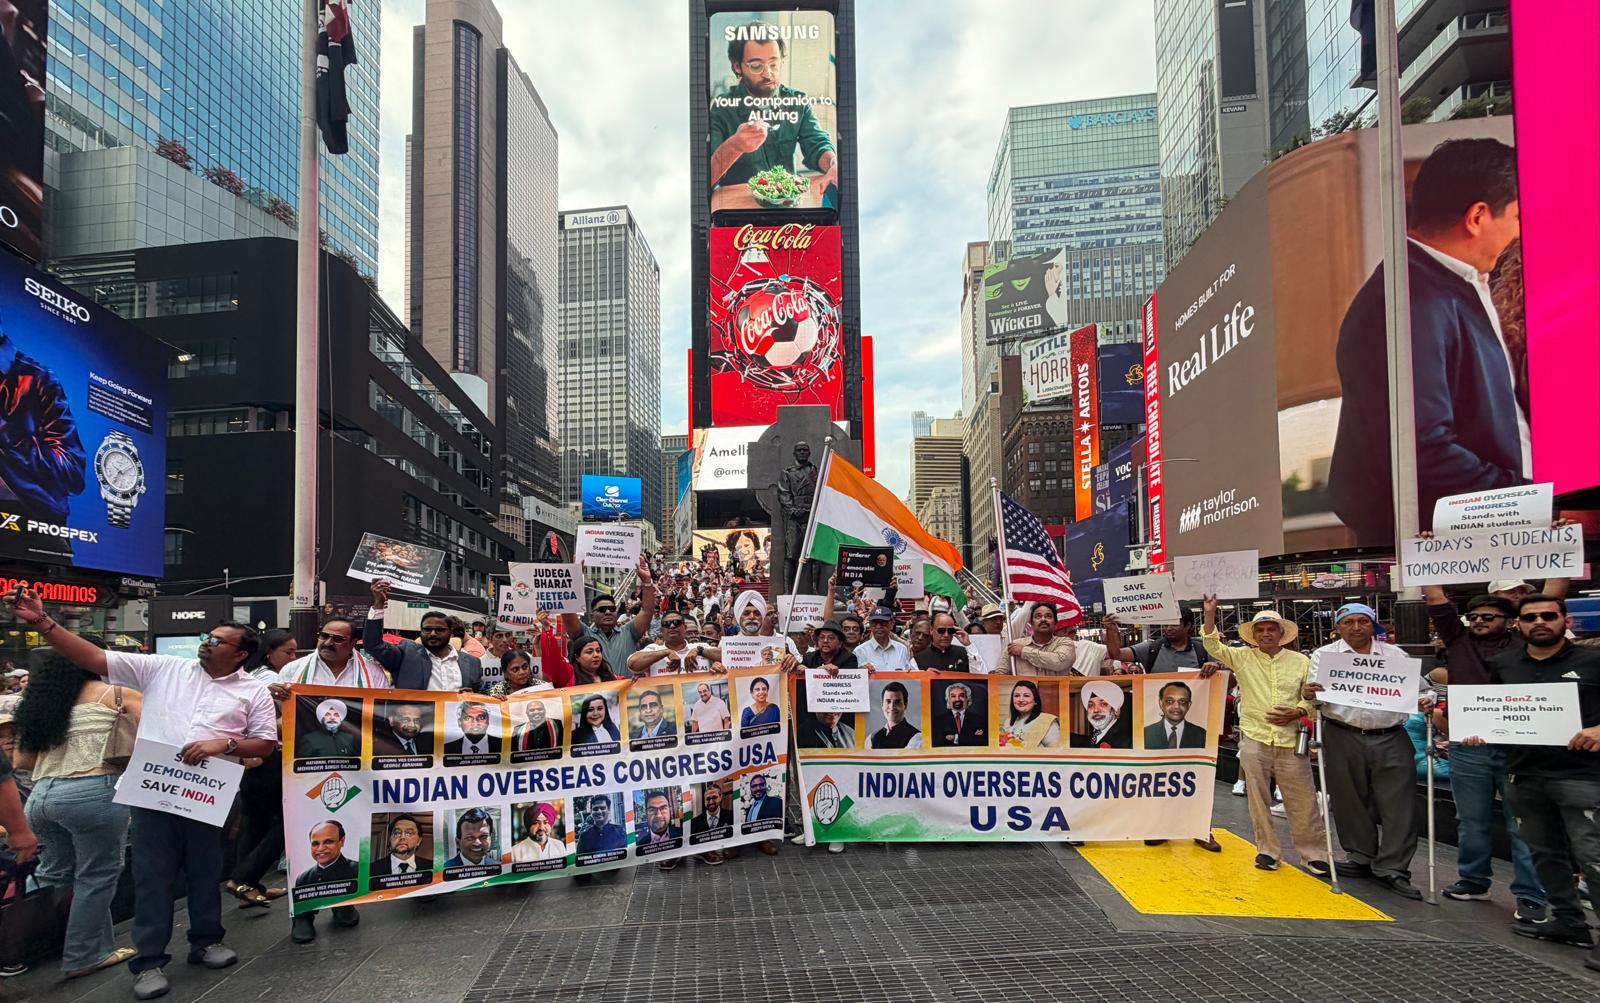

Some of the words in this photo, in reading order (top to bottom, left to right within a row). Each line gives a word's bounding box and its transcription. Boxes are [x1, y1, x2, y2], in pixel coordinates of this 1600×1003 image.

[725, 24, 819, 41] SAMSUNG
[715, 96, 742, 108] Your
[744, 95, 816, 110] Companion
[820, 94, 832, 106] to
[763, 109, 798, 124] Living
[1086, 110, 1156, 127] BARCLAYS
[572, 215, 604, 226] Allianz
[25, 278, 91, 322] SEIKO
[1175, 301, 1198, 331] HOMES
[1198, 280, 1218, 308] BUILT
[1220, 264, 1236, 288] FOR
[40, 302, 60, 316] SINCE
[1030, 335, 1067, 362] LITTLE
[1168, 334, 1207, 398] Real
[1210, 300, 1255, 364] Life
[1030, 357, 1068, 394] HORR
[1146, 360, 1158, 400] FREE
[90, 371, 108, 384] Keep
[108, 380, 127, 394] Going
[127, 389, 152, 405] Forward
[1078, 363, 1090, 418] ARTOIS
[1148, 400, 1161, 488] CHOCOLATE
[1082, 434, 1092, 489] STELLA
[1115, 462, 1132, 476] VOC
[714, 467, 748, 478] @ame
[1203, 488, 1236, 511] taylor
[1448, 496, 1481, 505] INDIAN
[1484, 490, 1538, 502] OVERSEAS
[1464, 501, 1518, 511] CONGRESS
[1204, 496, 1260, 526] morrison.
[27, 520, 98, 543] PROSPEX
[1450, 522, 1483, 530] INDIAN
[1486, 519, 1531, 528] students
[1414, 537, 1472, 553] TODAY'S
[1491, 526, 1577, 548] STUDENTS,
[1501, 552, 1575, 570] FUTURE
[533, 568, 571, 578] JUDEGA
[534, 578, 572, 589] BHARAT
[1123, 583, 1146, 591] SAVE
[34, 582, 97, 603] CAMINOS
[535, 591, 577, 601] JEETEGA
[1112, 592, 1163, 603] DEMOCRACY
[504, 604, 515, 612] FO
[536, 601, 564, 610] INDIA
[1116, 606, 1138, 614] SAVE
[1139, 603, 1163, 612] INDIA
[172, 611, 206, 620] HOPE
[1352, 657, 1386, 668] SAVE
[1329, 670, 1407, 684] DEMOCRACY
[1331, 683, 1364, 693] SAVE
[1367, 686, 1402, 697] INDIA
[143, 762, 226, 790] DEMOCRACY
[372, 774, 468, 804] INDIAN
[478, 764, 606, 798] OVERSEAS
[613, 750, 733, 784] CONGRESS
[739, 742, 777, 767] USA
[140, 779, 180, 795] SAVE
[181, 788, 215, 805] INDIA
[858, 771, 935, 798] INDIAN
[943, 771, 1062, 799] OVERSEAS
[1070, 771, 1196, 798] CONGRESS
